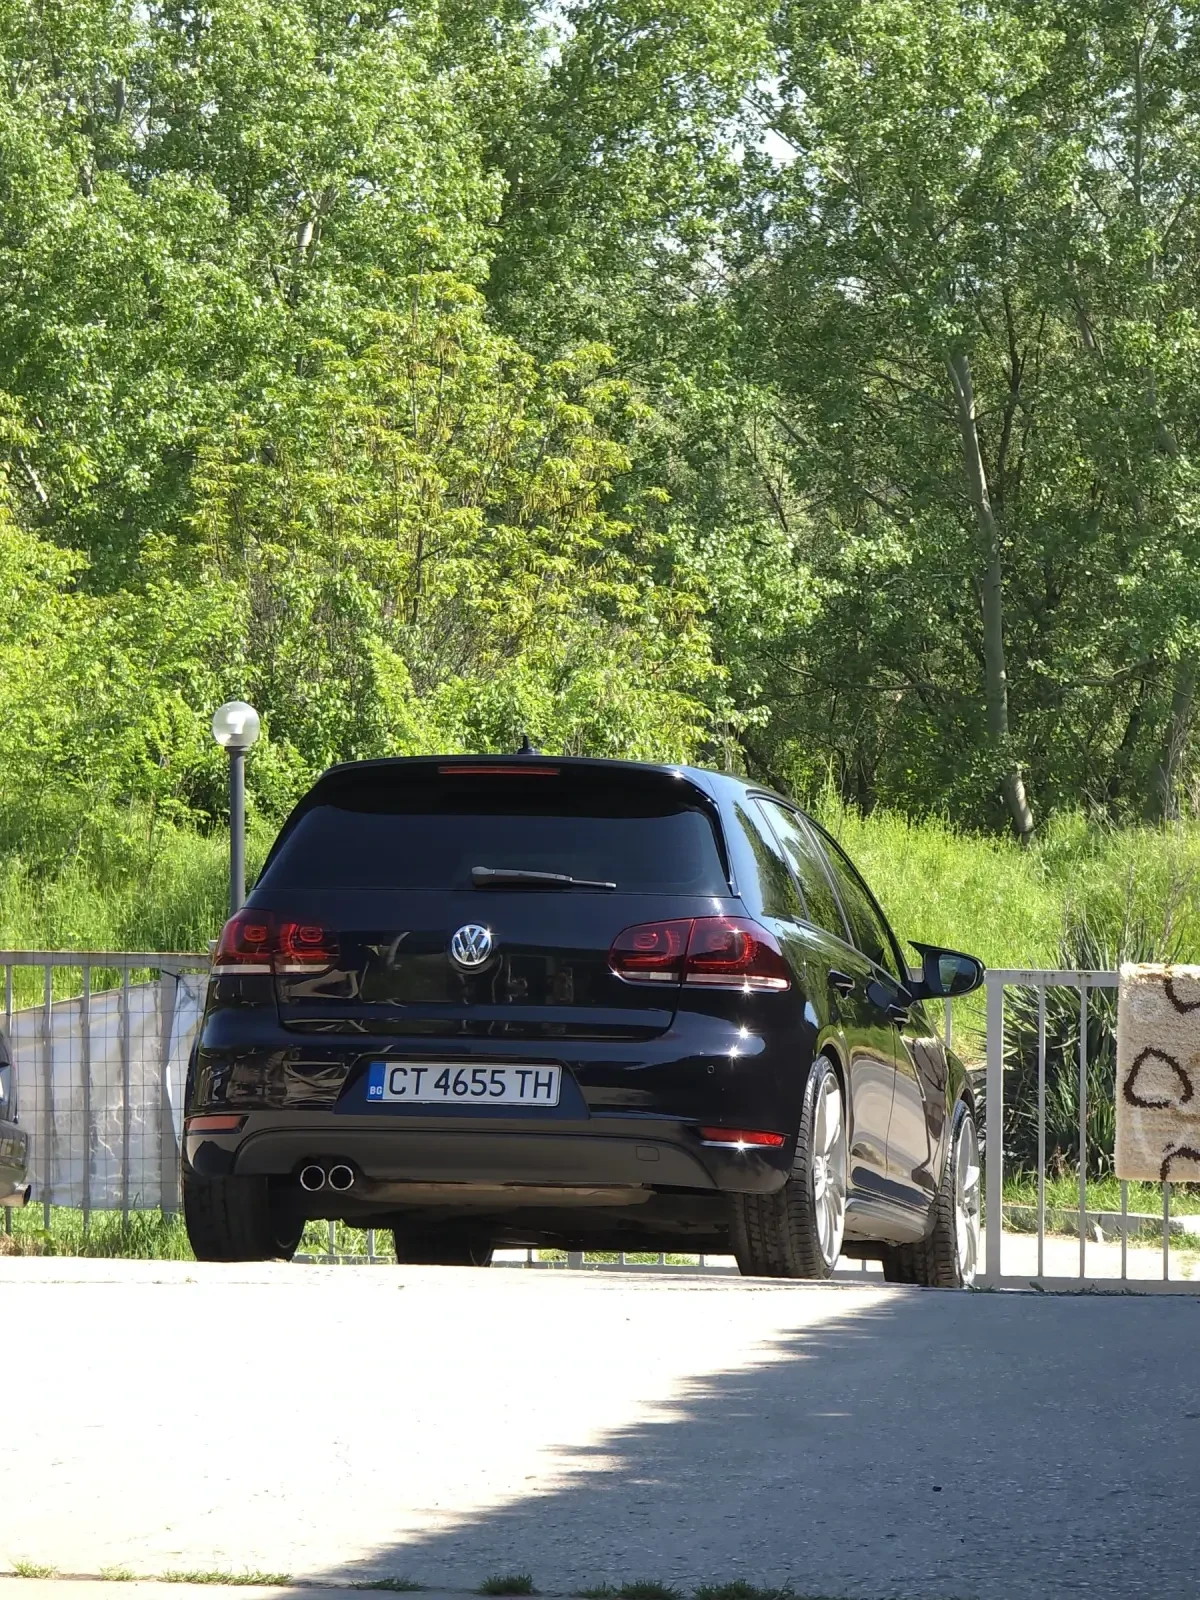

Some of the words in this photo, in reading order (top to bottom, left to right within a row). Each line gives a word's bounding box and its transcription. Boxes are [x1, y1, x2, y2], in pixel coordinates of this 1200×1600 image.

[452, 925, 492, 965] VW
[369, 1086, 383, 1095] BG
[389, 1068, 428, 1095] CT
[434, 1069, 506, 1097] 4655
[515, 1070, 553, 1098] TH
